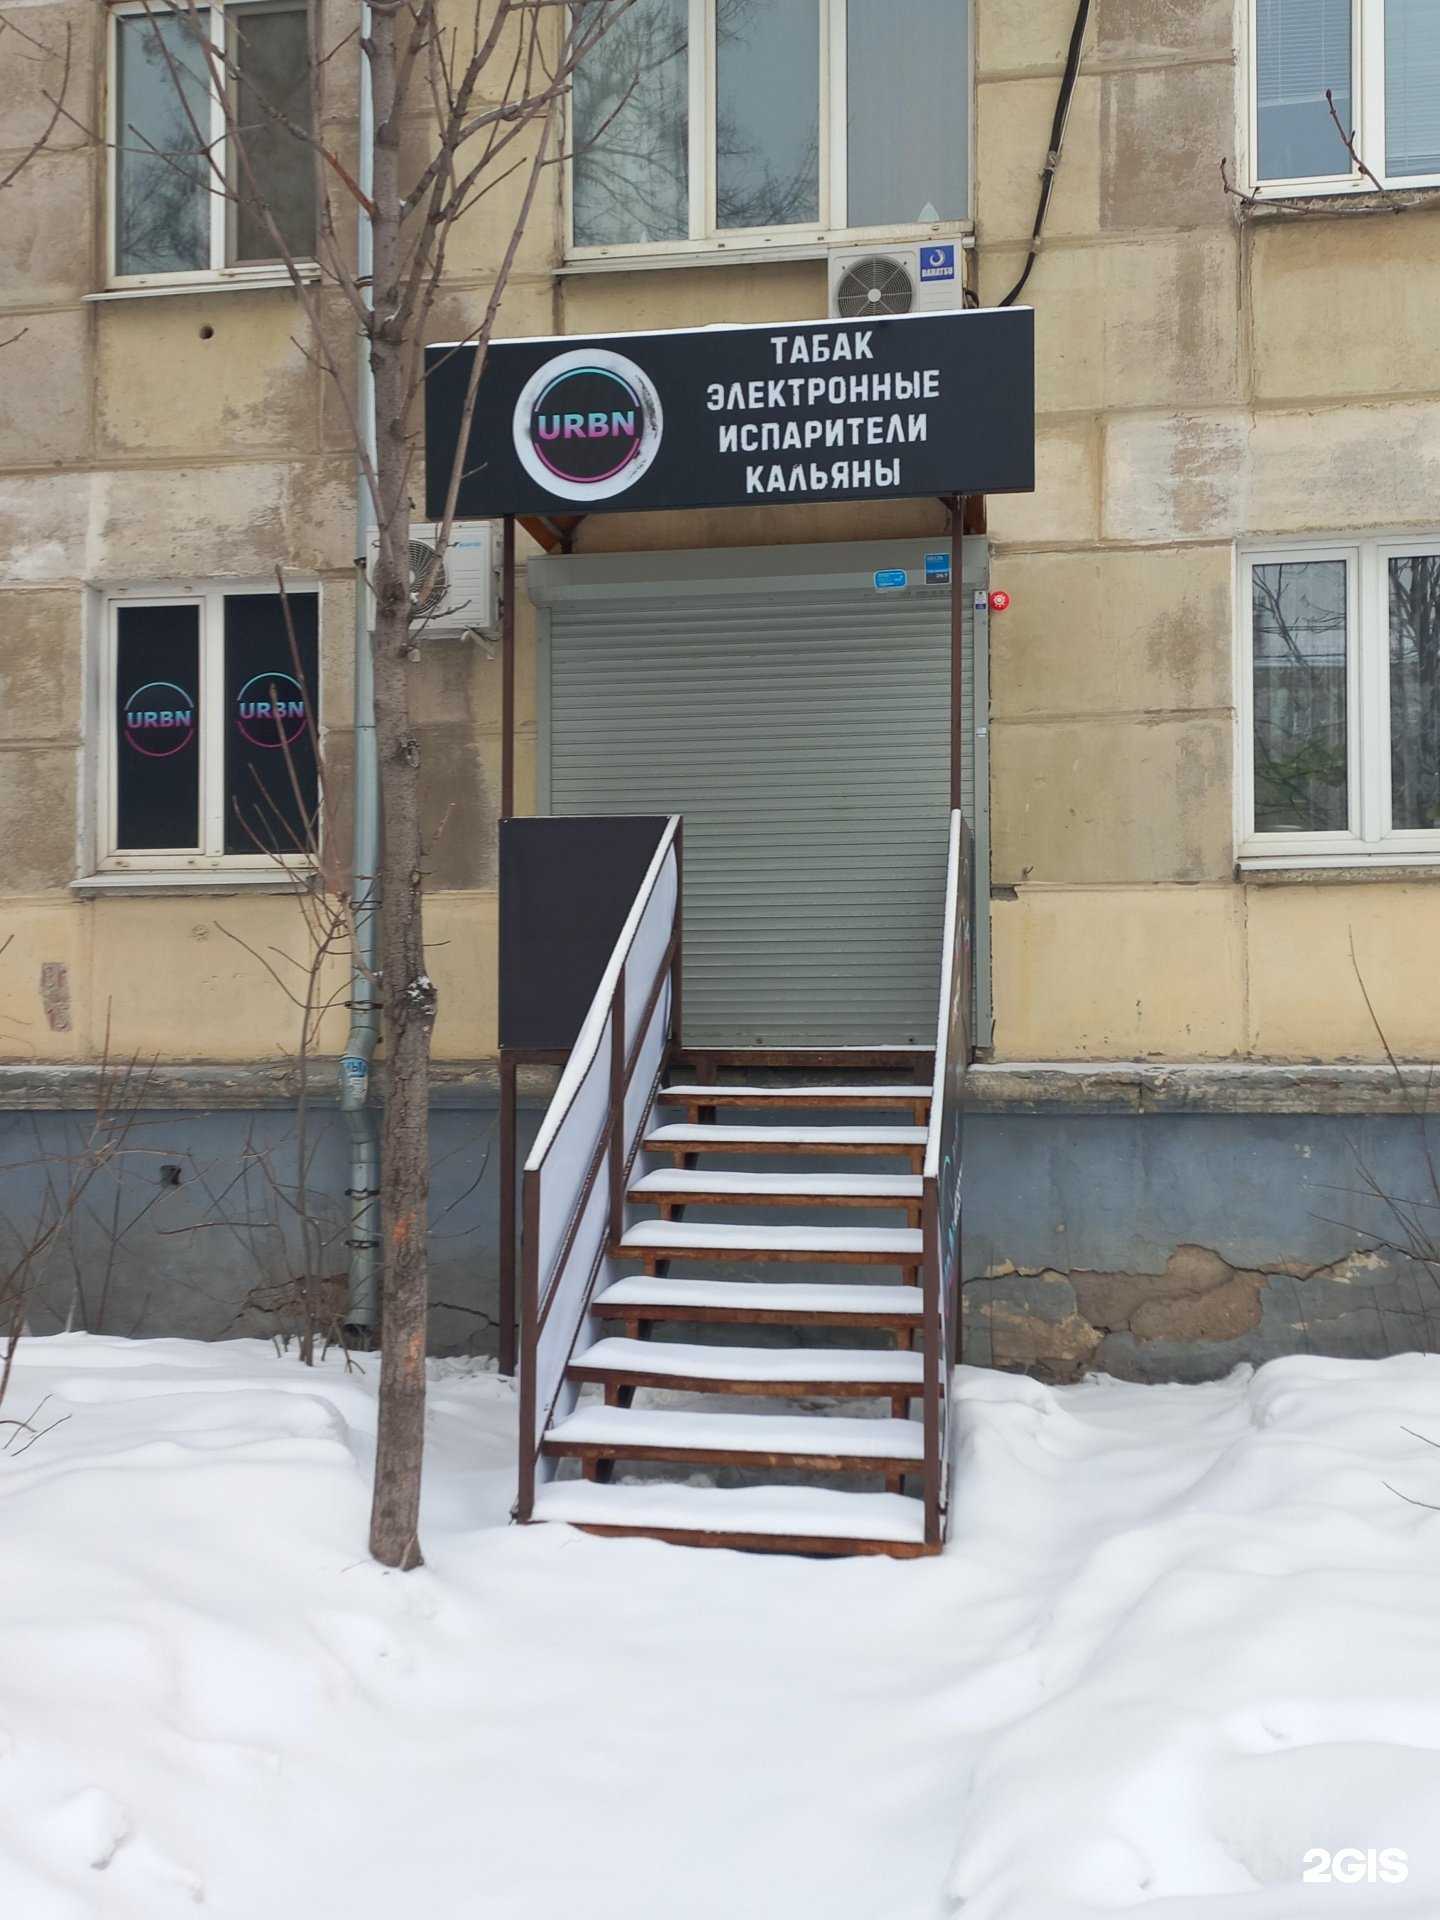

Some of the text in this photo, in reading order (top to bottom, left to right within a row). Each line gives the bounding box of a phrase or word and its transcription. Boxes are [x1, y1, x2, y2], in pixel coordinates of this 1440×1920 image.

[771, 331, 873, 364] ТАБАК
[707, 370, 939, 410] ЭЛЕКТРОННЫЕ
[539, 411, 634, 441] URBN
[719, 414, 927, 452] ИСПАРИТЕЛИ
[746, 458, 899, 494] КАЛЬЯНЫ
[127, 711, 191, 728] URBN
